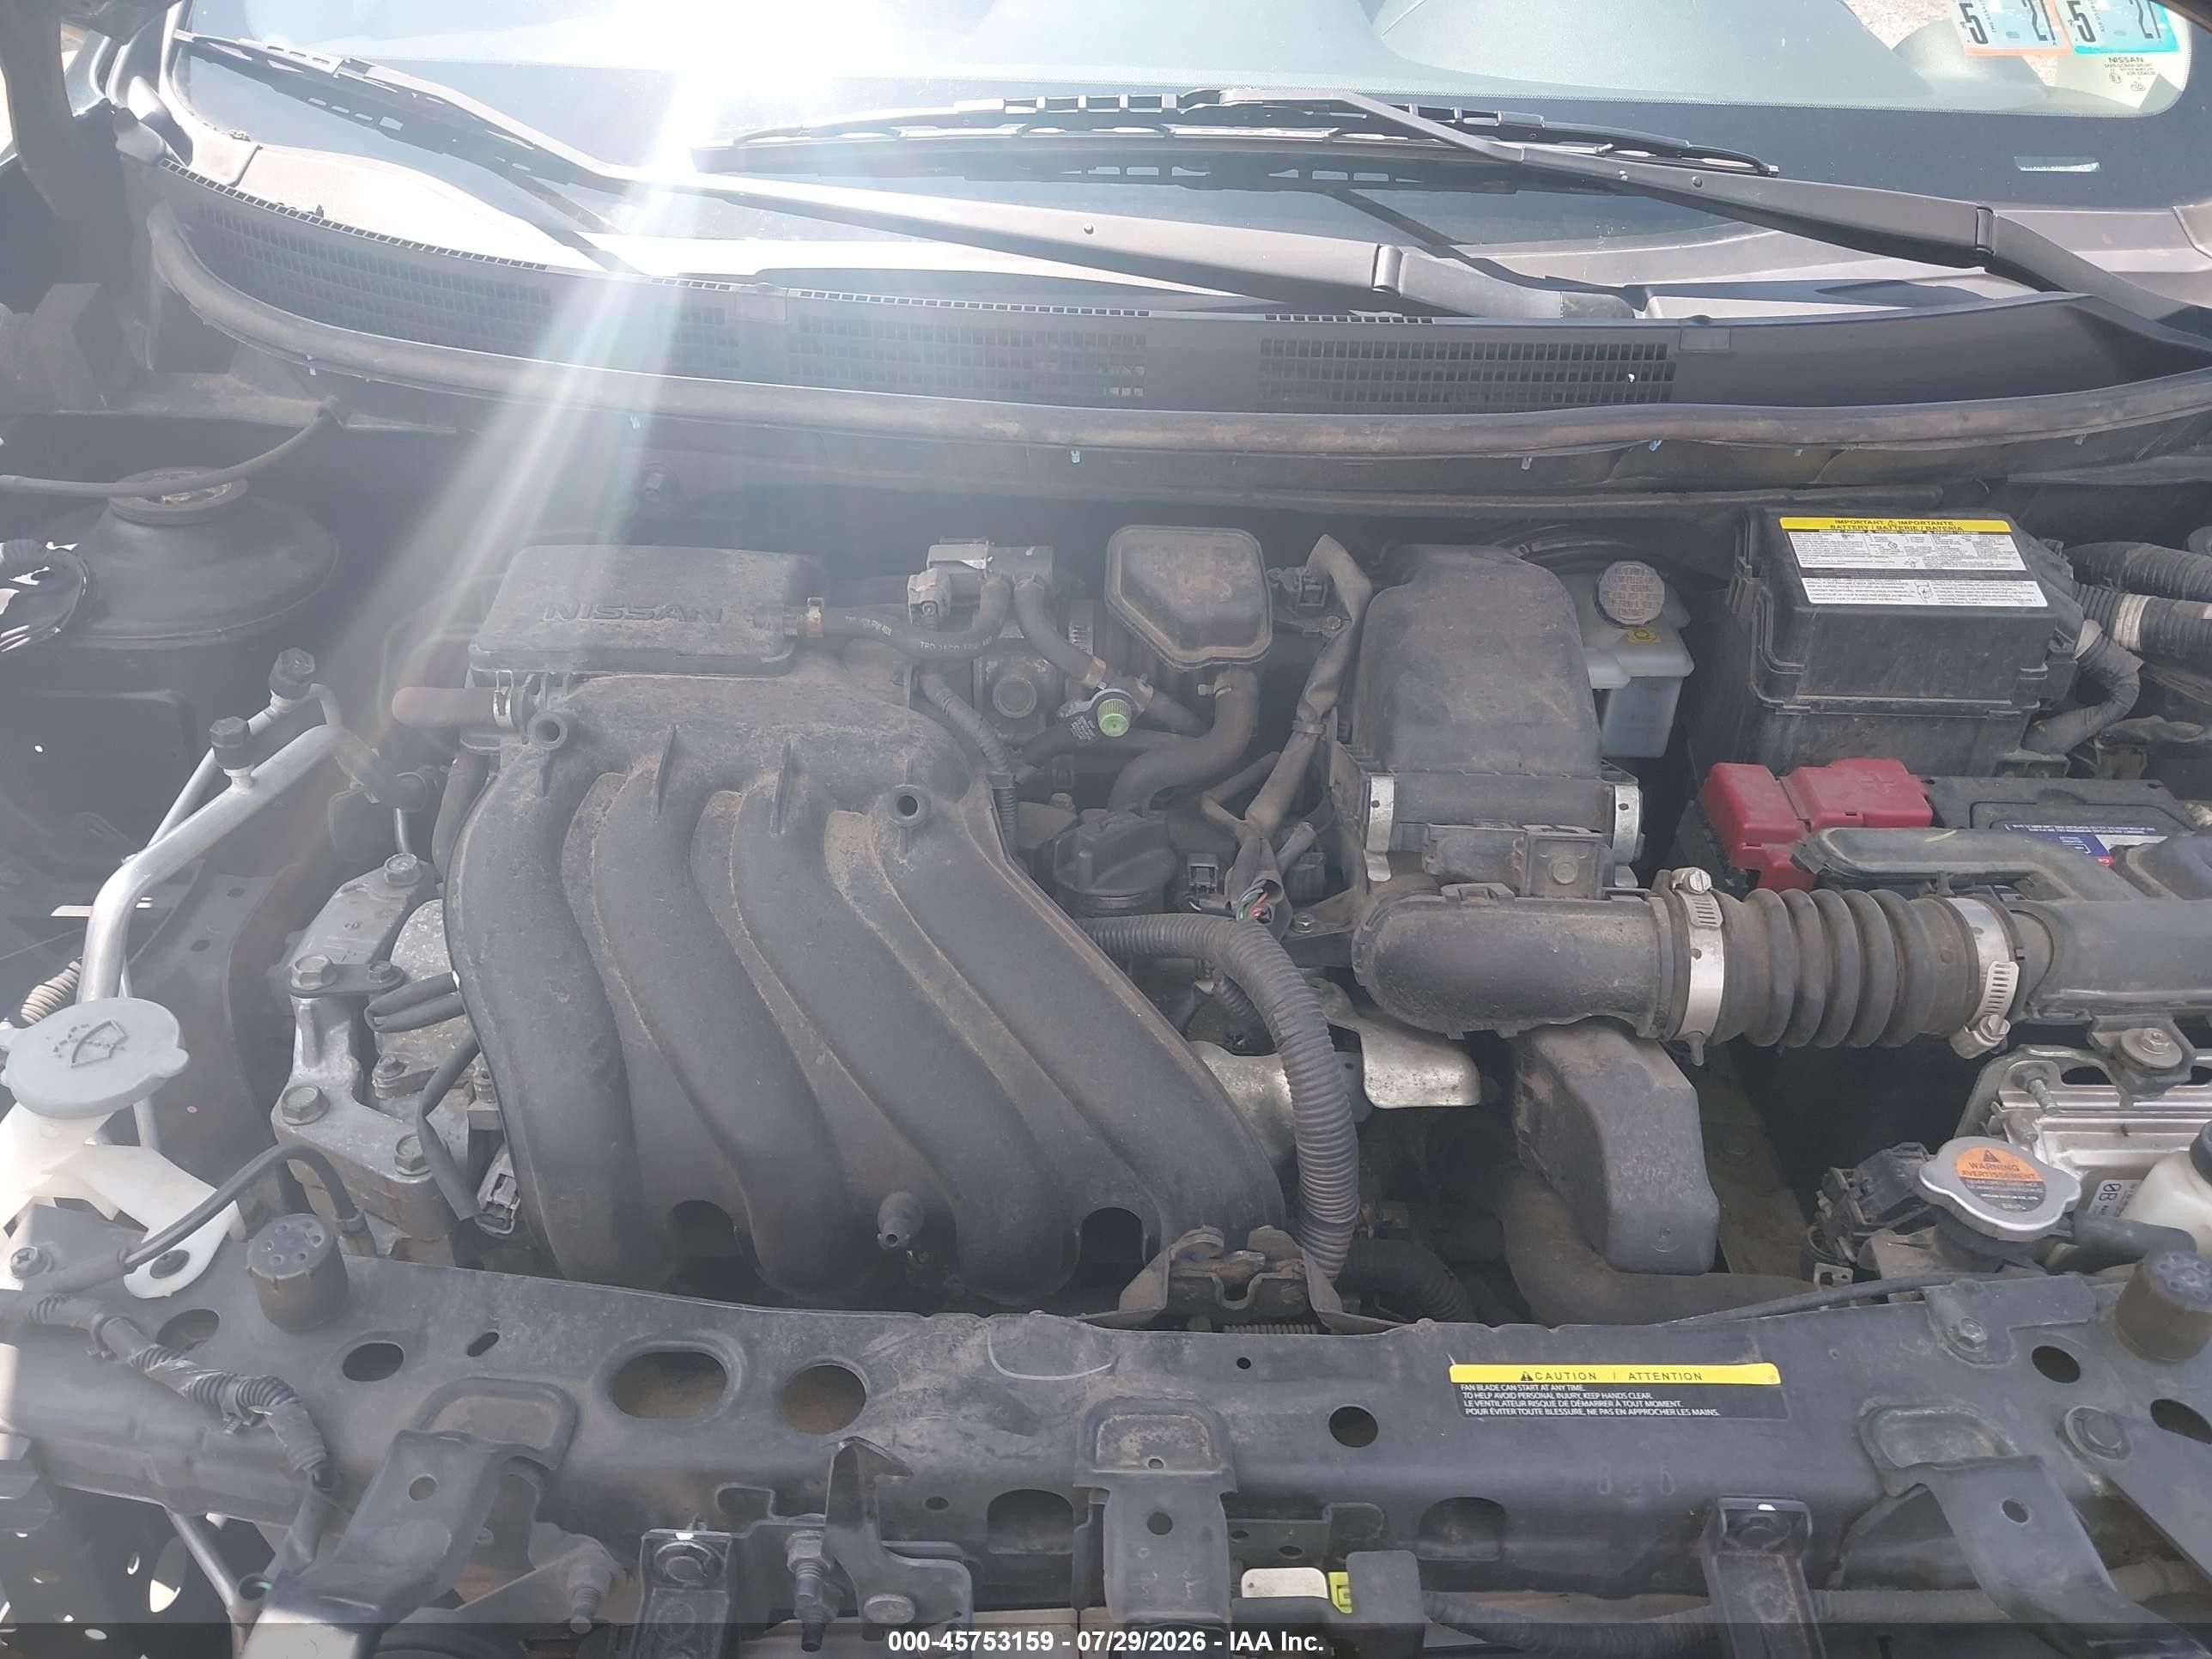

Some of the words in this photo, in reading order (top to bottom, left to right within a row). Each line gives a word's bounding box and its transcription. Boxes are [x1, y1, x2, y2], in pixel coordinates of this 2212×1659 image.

[1959, 3, 1989, 45] 5
[2066, 0, 2096, 43] 5
[544, 603, 724, 623] NISSAN
[1969, 1162, 2021, 1172] WARNING
[1962, 1170, 2036, 1181] AVERTISSEMENT
[1534, 1371, 1596, 1381] CAUTION
[1628, 1372, 1703, 1381] ATTENTION
[1528, 1400, 1557, 1408] RISQUE
[1571, 1399, 1613, 1407] DÉMARRER
[1489, 1407, 1516, 1416] ÉVITER
